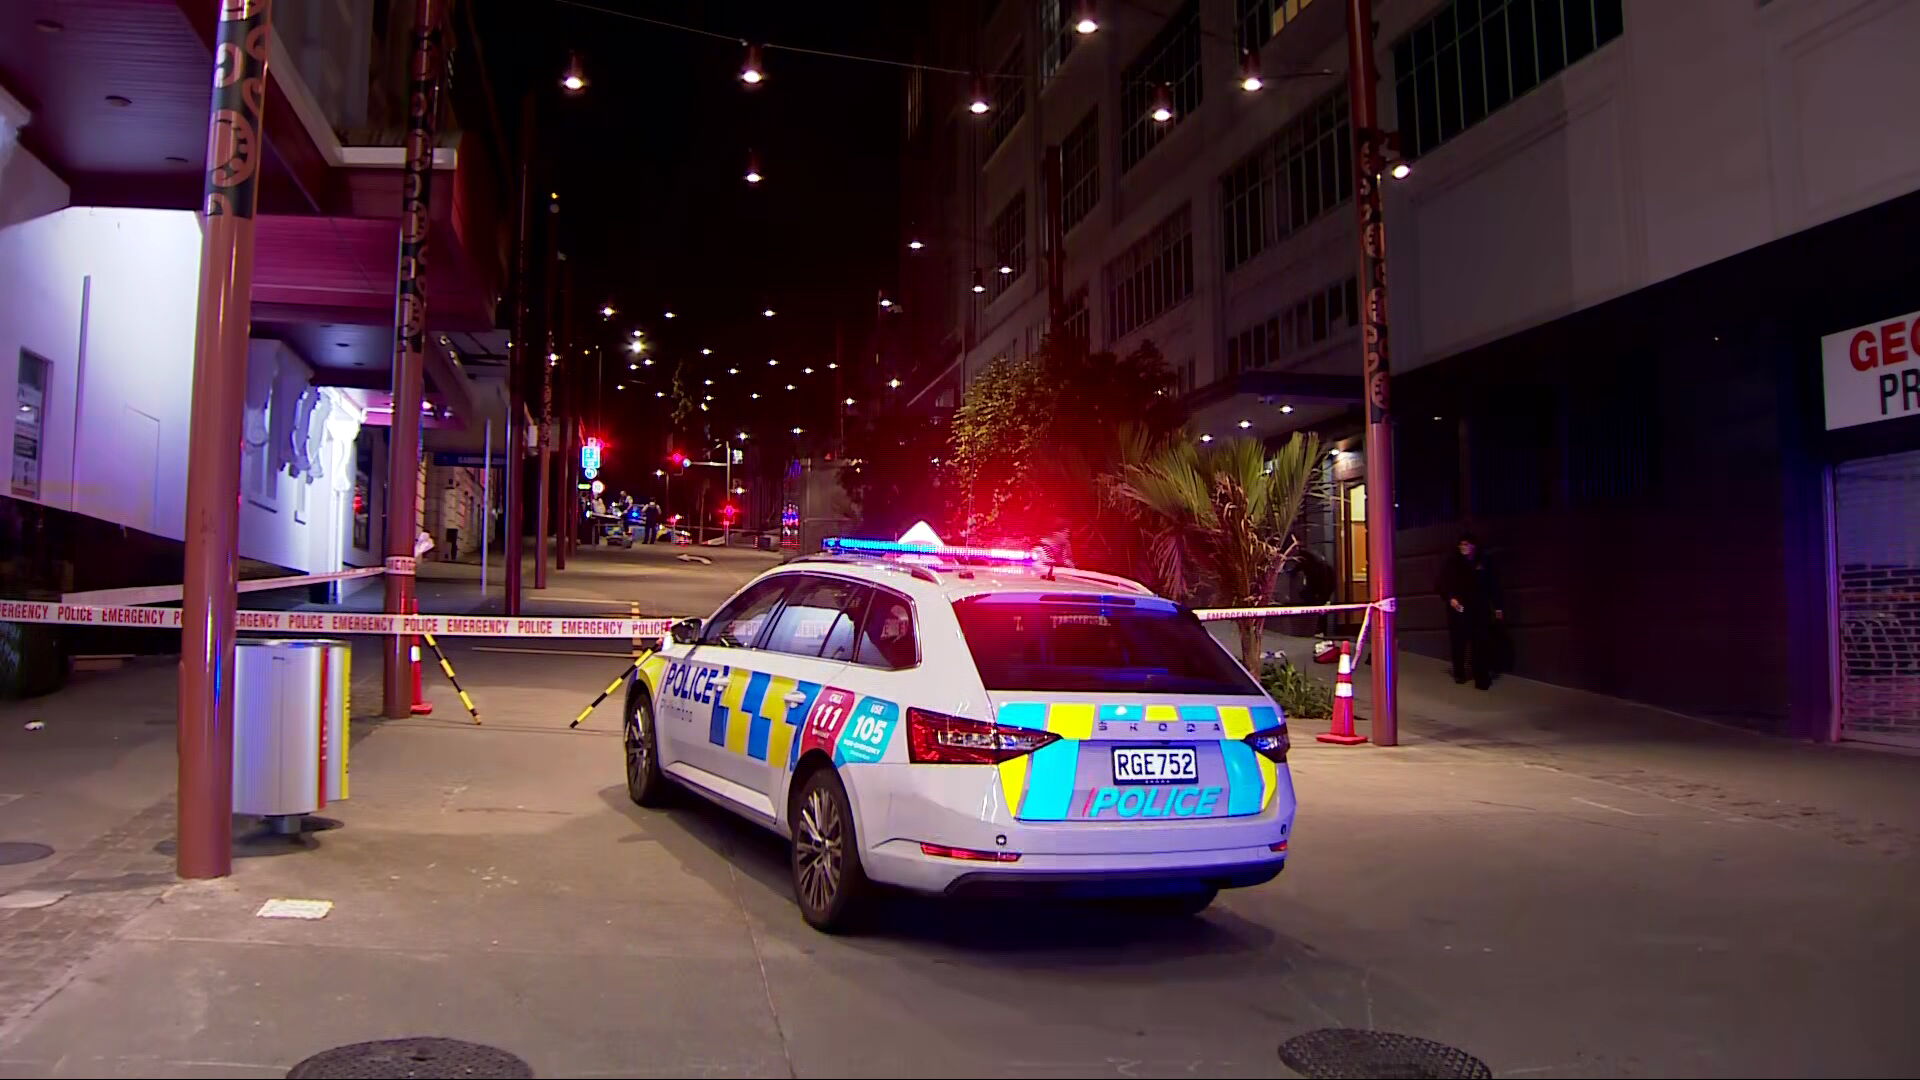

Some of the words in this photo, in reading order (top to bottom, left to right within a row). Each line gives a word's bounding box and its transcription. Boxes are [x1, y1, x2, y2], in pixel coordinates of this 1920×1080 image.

[0, 603, 48, 619] ERGENCY
[57, 606, 93, 621] POLICE
[102, 608, 165, 624] EMERGENCY
[289, 615, 323, 629] POLICE
[333, 616, 393, 631] EMERGENCY
[403, 618, 438, 632] POLICE
[447, 619, 509, 633] EMERGENCY
[518, 620, 552, 634] POLICE
[562, 621, 623, 635] EMERGENCY
[632, 621, 666, 635] POLICE
[663, 662, 719, 704] POLICE
[813, 703, 843, 731] 111
[852, 714, 888, 745] 105
[1117, 753, 1194, 776] RGE752
[1088, 786, 1223, 818] POLICE
